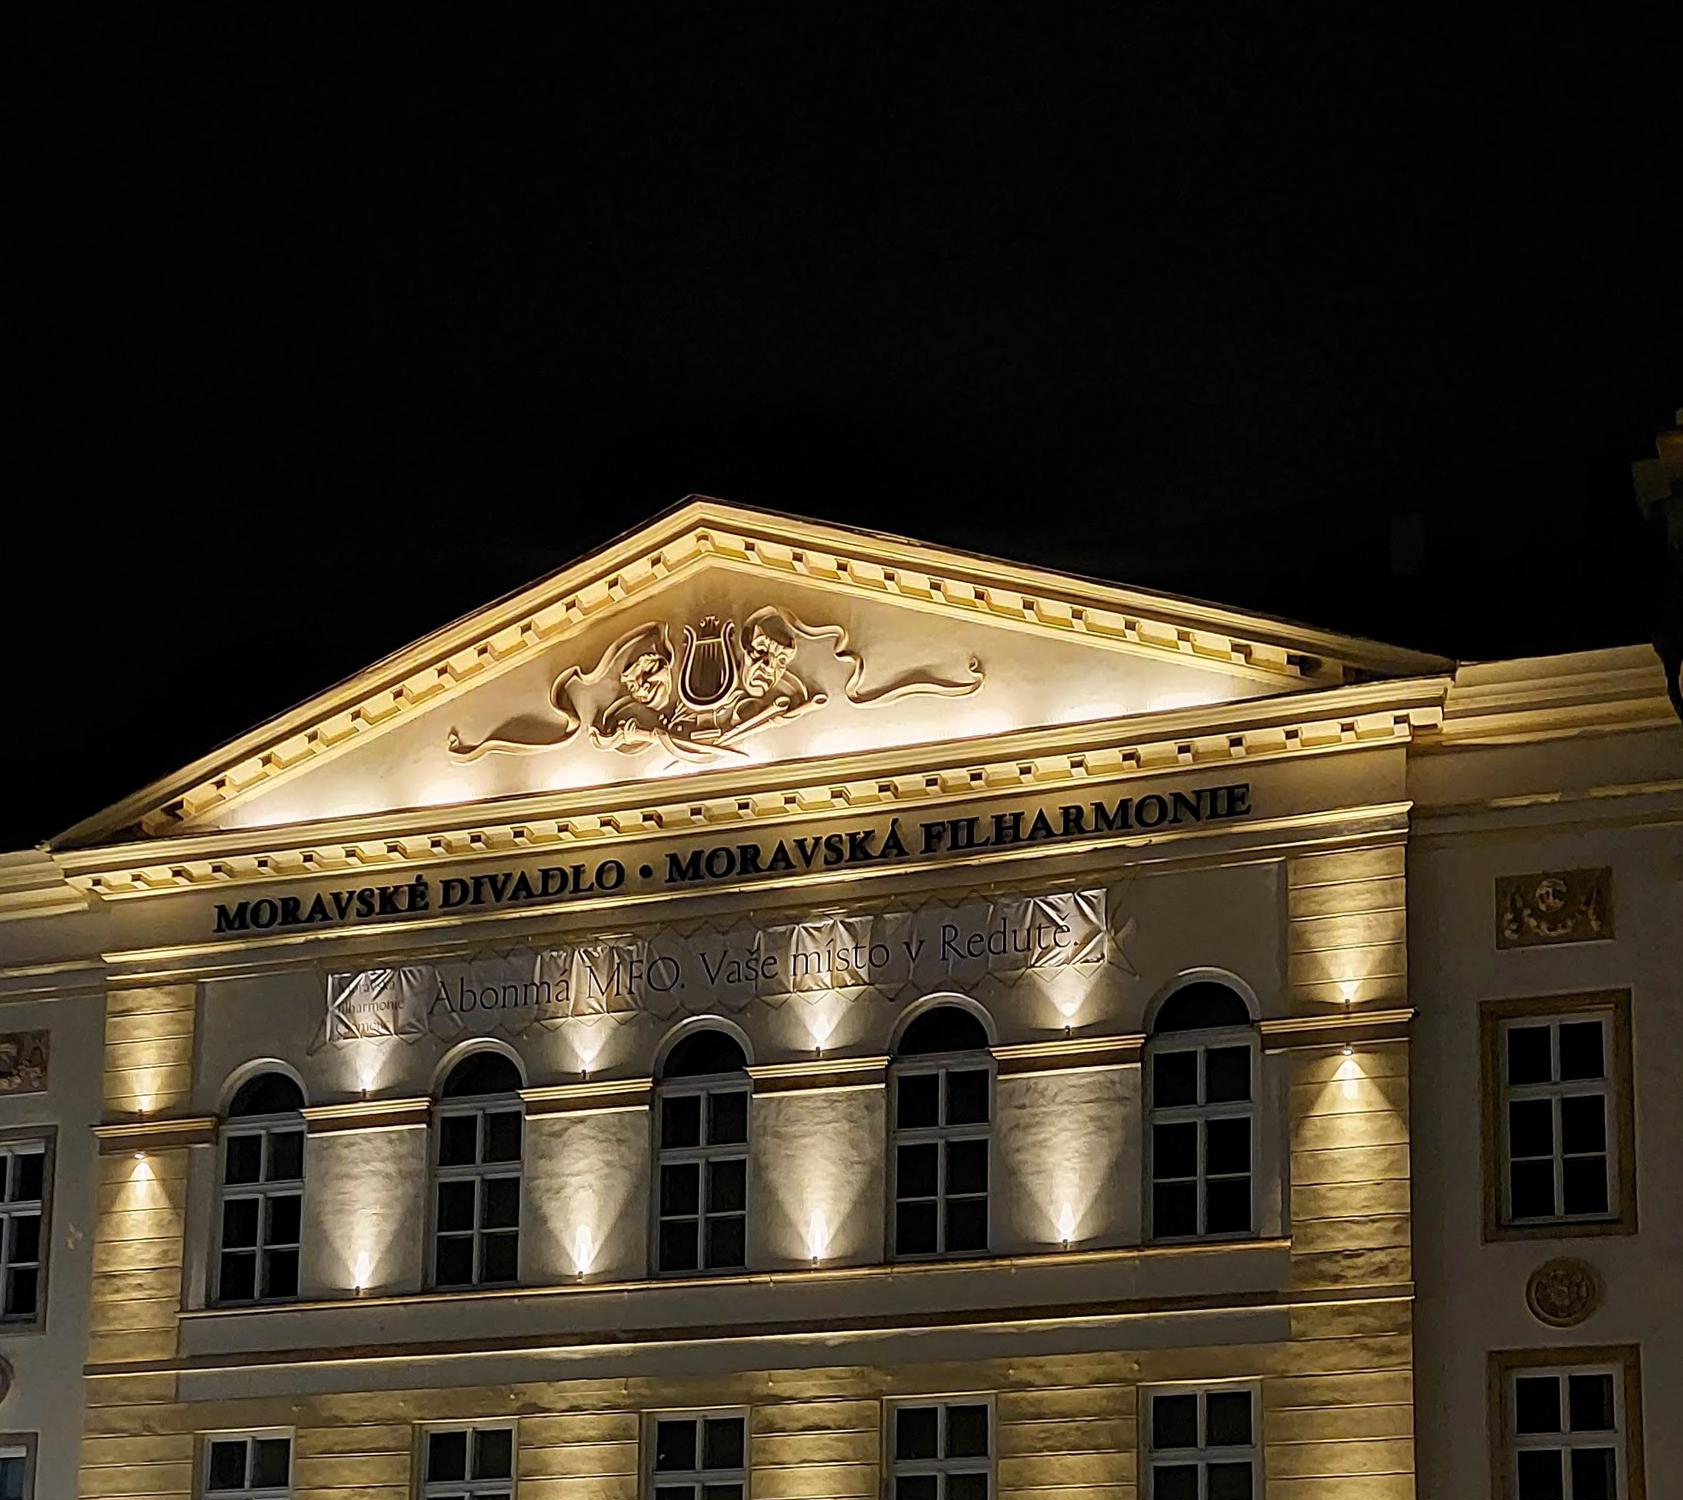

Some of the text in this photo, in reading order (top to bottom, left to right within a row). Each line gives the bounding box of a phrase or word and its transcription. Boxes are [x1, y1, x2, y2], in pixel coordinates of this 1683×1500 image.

[213, 782, 1252, 933] MORAVSKÉ DIVADLO MORAVSKÁ FILHARMONIE
[429, 968, 570, 1014] Abonmá
[588, 957, 685, 998] MFO.
[700, 949, 778, 986] Vaše
[792, 940, 890, 976] místo
[902, 939, 924, 963] v
[941, 912, 1080, 962] Redutě.
